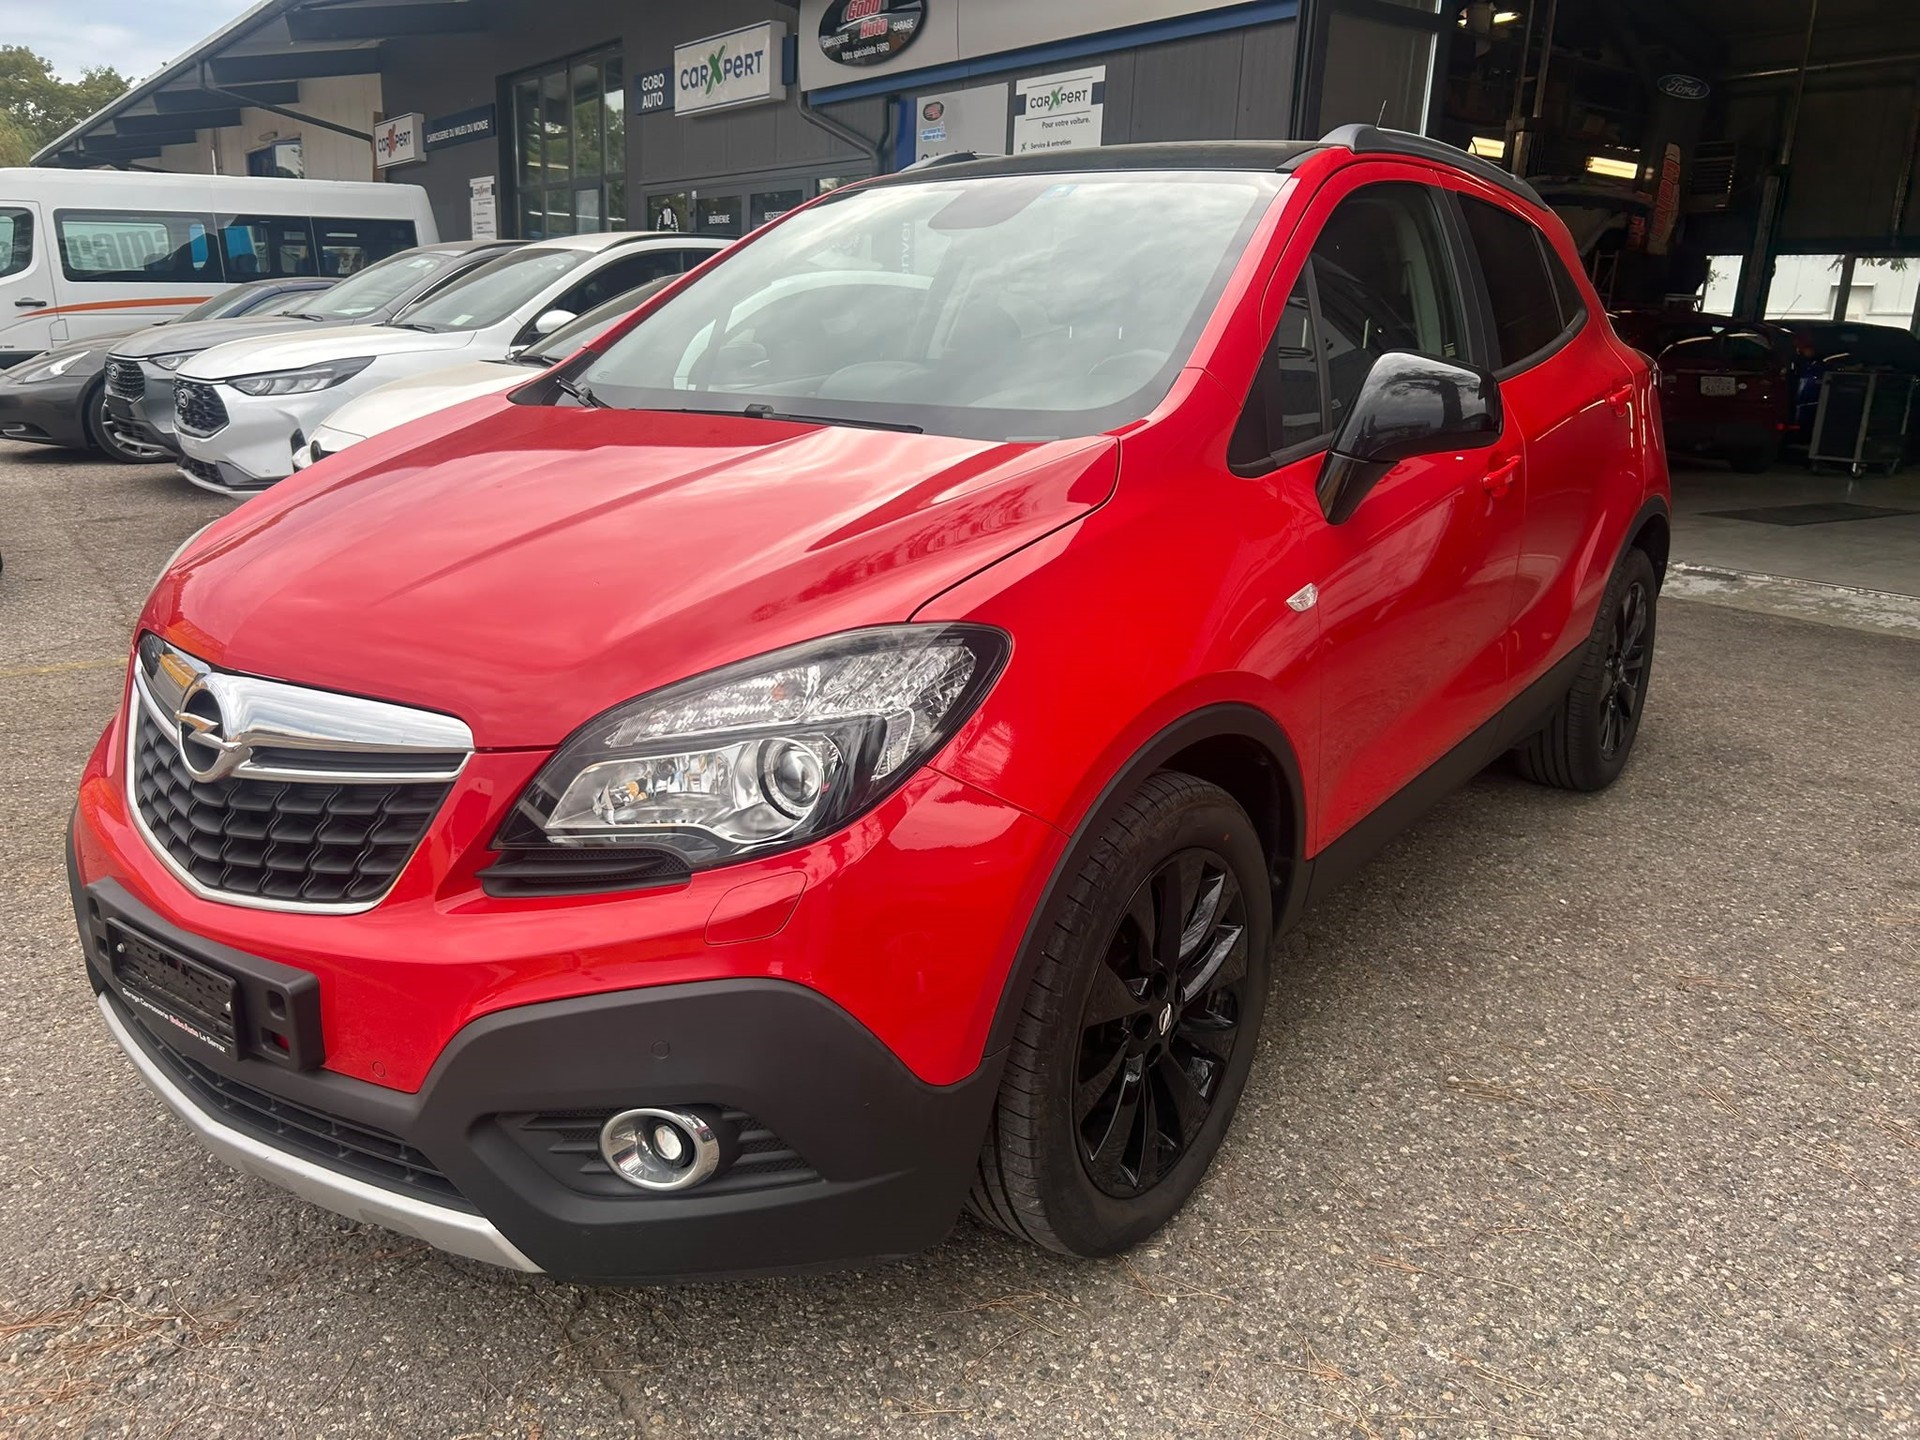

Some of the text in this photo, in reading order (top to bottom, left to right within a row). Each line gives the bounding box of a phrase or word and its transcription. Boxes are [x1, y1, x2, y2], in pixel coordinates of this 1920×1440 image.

[860, 17, 888, 39] Auto
[642, 73, 665, 91] GOBO
[642, 91, 664, 109] AUTO
[1041, 121, 1054, 129] Pour
[1055, 119, 1069, 128] votre
